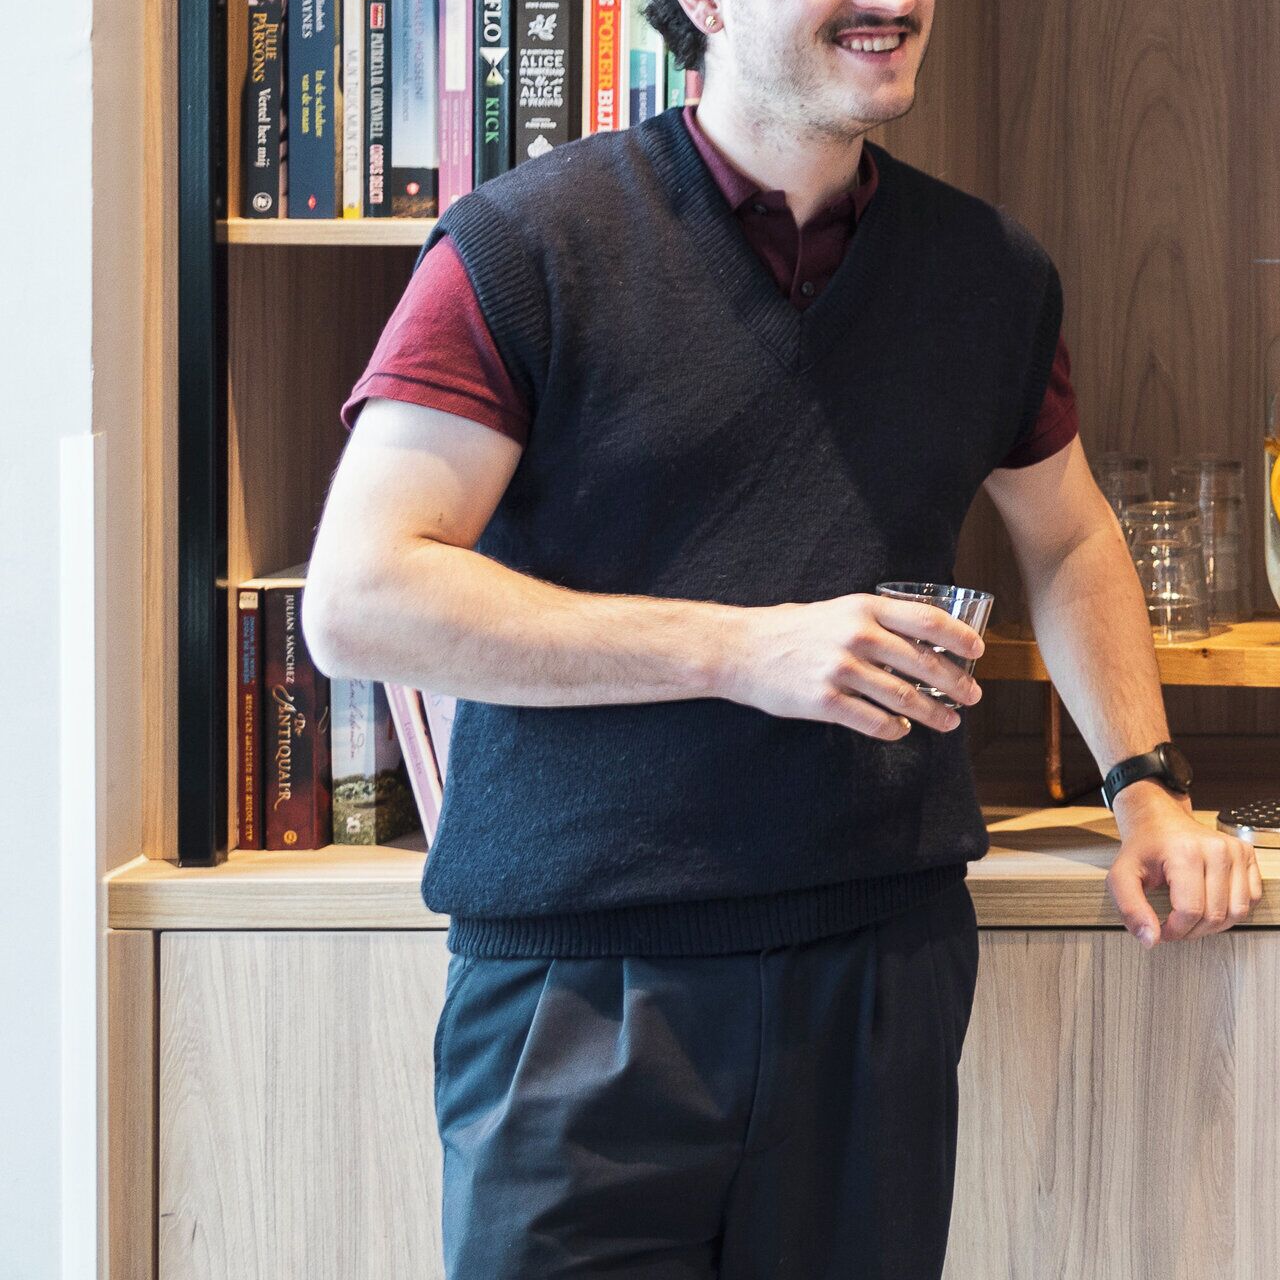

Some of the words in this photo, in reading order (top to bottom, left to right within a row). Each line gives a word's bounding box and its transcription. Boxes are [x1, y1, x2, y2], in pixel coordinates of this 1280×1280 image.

[251, 12, 268, 83] PARSONS
[265, 23, 279, 60] JULIE
[521, 55, 563, 68] ALICE
[520, 86, 562, 98] ALICE
[485, 97, 499, 144] KICK
[272, 684, 297, 812] ANTIQUAIR
